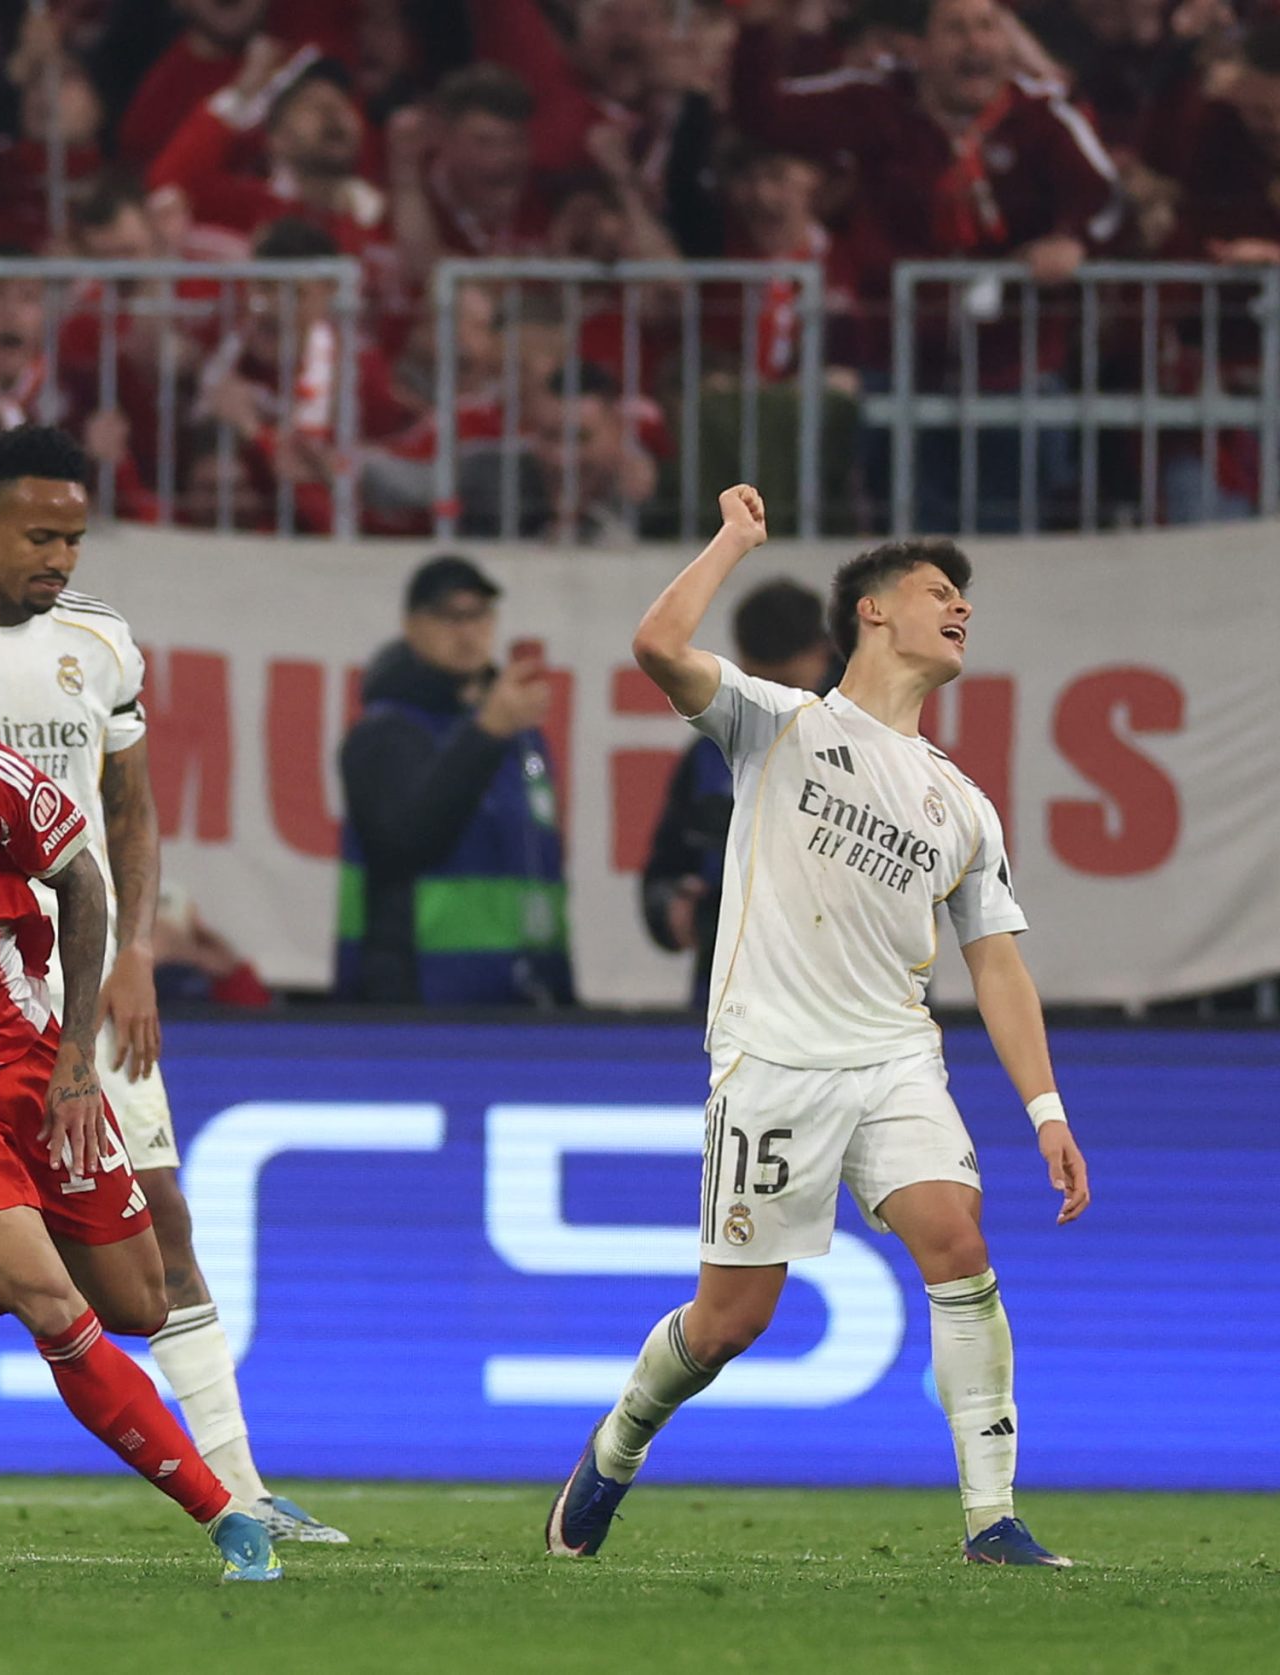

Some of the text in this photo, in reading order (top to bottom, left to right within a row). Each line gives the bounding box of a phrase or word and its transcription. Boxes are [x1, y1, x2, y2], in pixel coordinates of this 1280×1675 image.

[42, 807, 82, 856] Allianz
[798, 779, 940, 873] Emirates
[807, 826, 914, 894] FLY BETTER
[730, 1126, 793, 1194] 15
